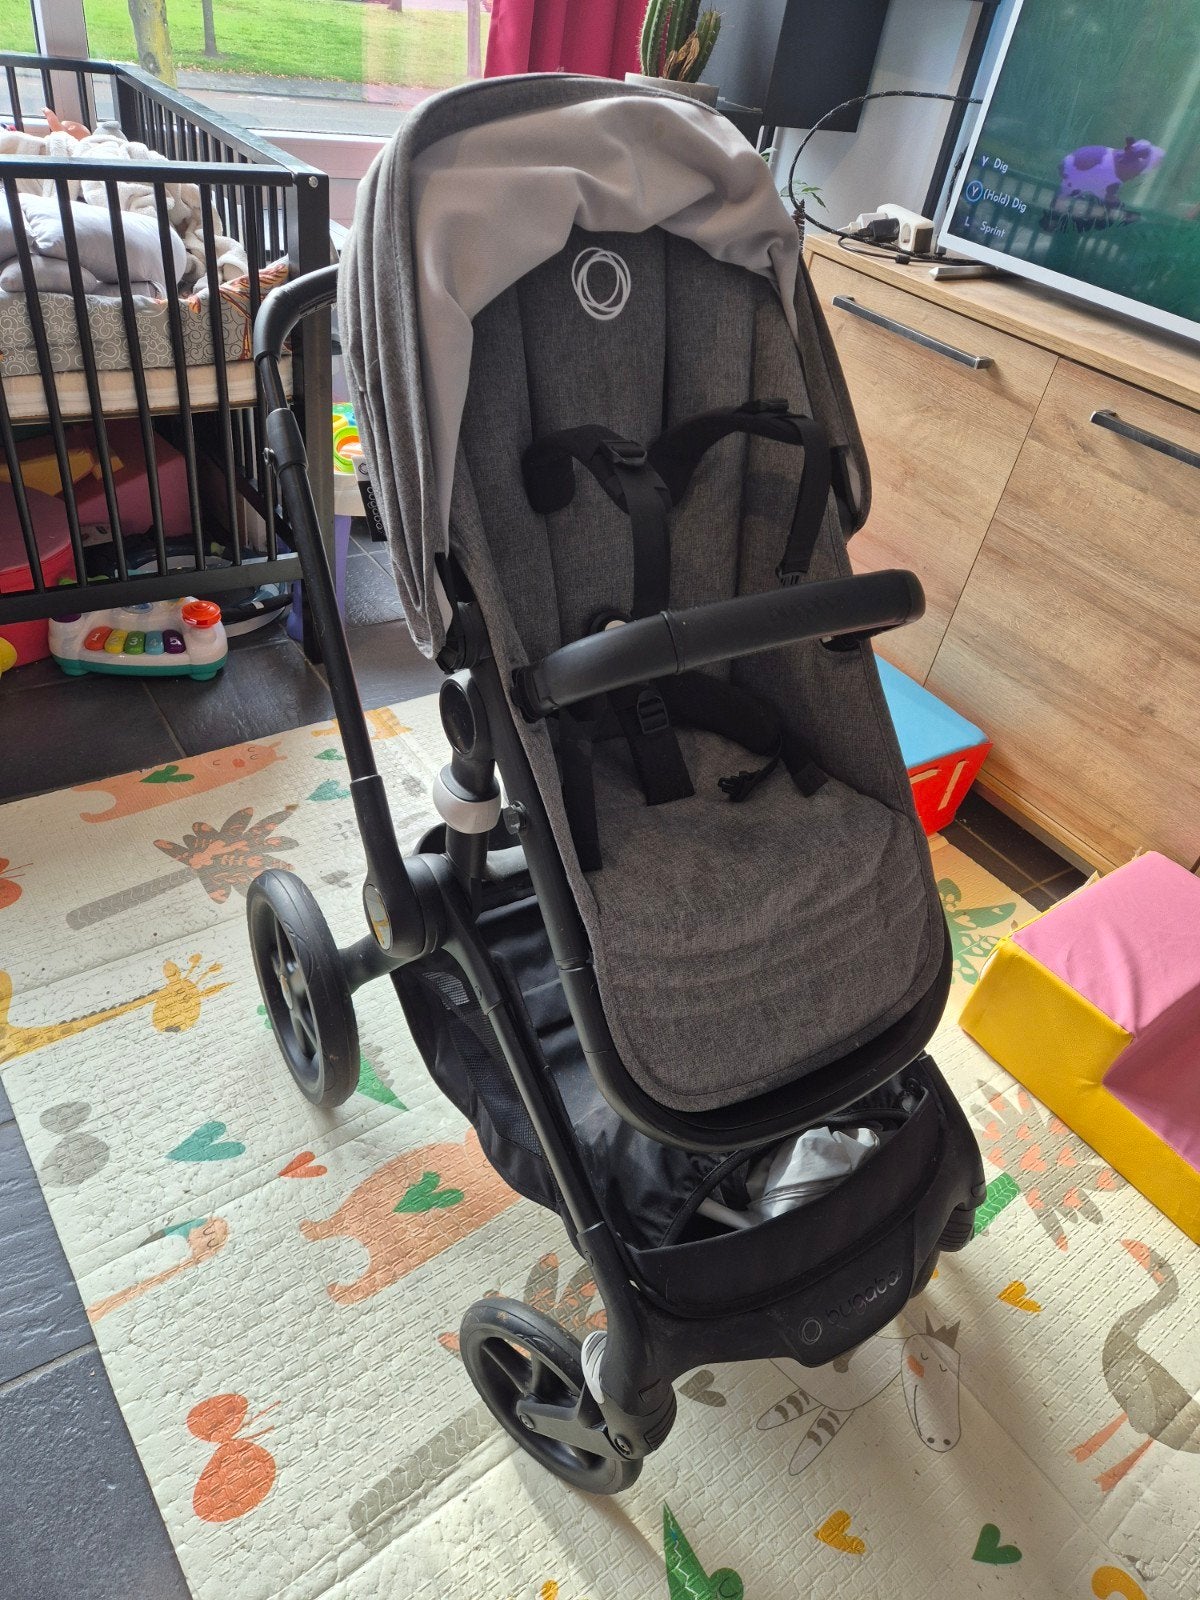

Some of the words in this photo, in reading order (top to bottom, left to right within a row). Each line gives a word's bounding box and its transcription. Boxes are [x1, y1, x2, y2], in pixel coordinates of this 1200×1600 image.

[982, 155, 989, 166] Y
[993, 157, 1009, 173] Dig
[983, 188, 1011, 207] (Hold)
[1012, 197, 1027, 213] Dig
[964, 216, 970, 227] L
[980, 220, 1006, 237] Sprint
[129, 637, 138, 646] 3
